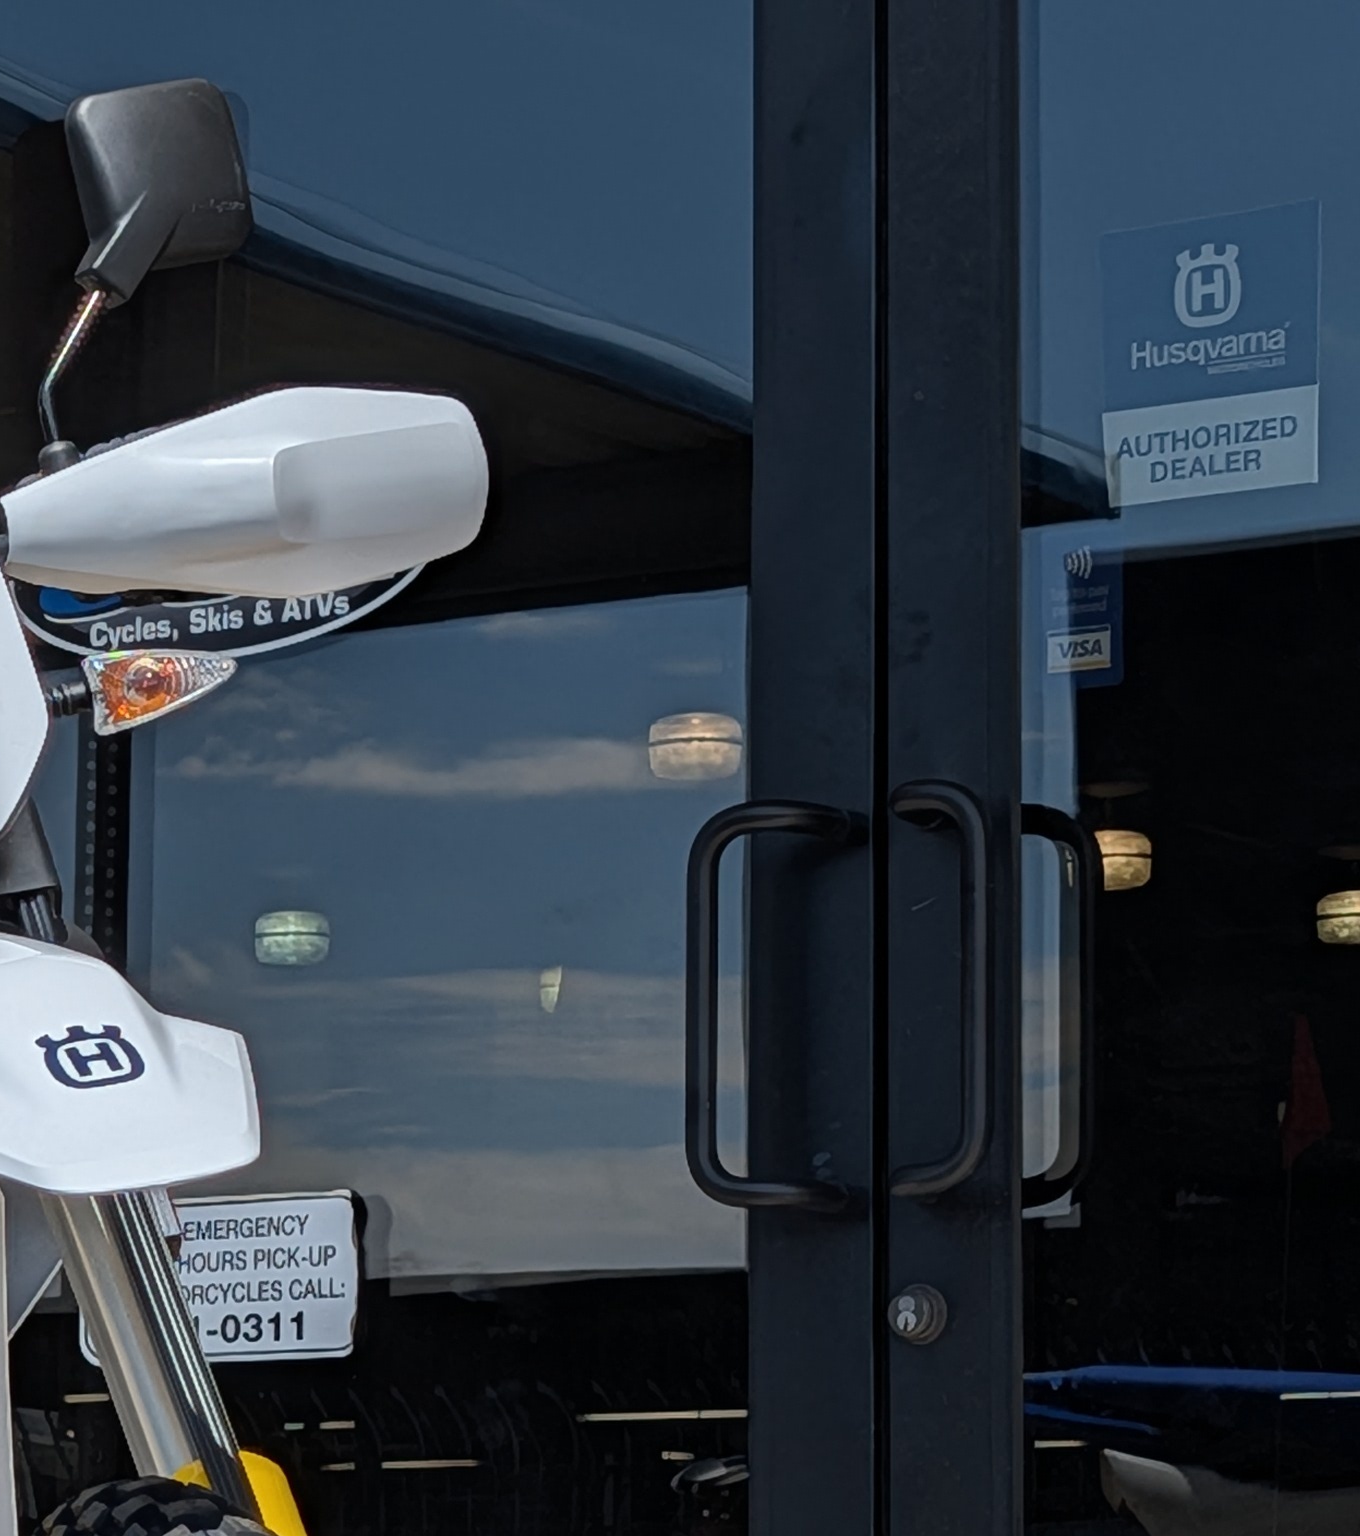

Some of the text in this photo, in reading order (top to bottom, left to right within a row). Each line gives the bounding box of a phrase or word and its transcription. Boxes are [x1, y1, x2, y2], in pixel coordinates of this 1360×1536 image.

[1130, 328, 1286, 370] Husqvarna
[1118, 414, 1298, 460] AUTHORIZED
[1149, 449, 1262, 484] DEALER
[90, 591, 351, 650] Cycles, Skis & ATVs
[1058, 638, 1104, 660] VISA
[183, 1214, 310, 1242] EMERGENCY
[178, 1245, 338, 1275] HOURS PICK-UP
[288, 1277, 347, 1301] CALL:
